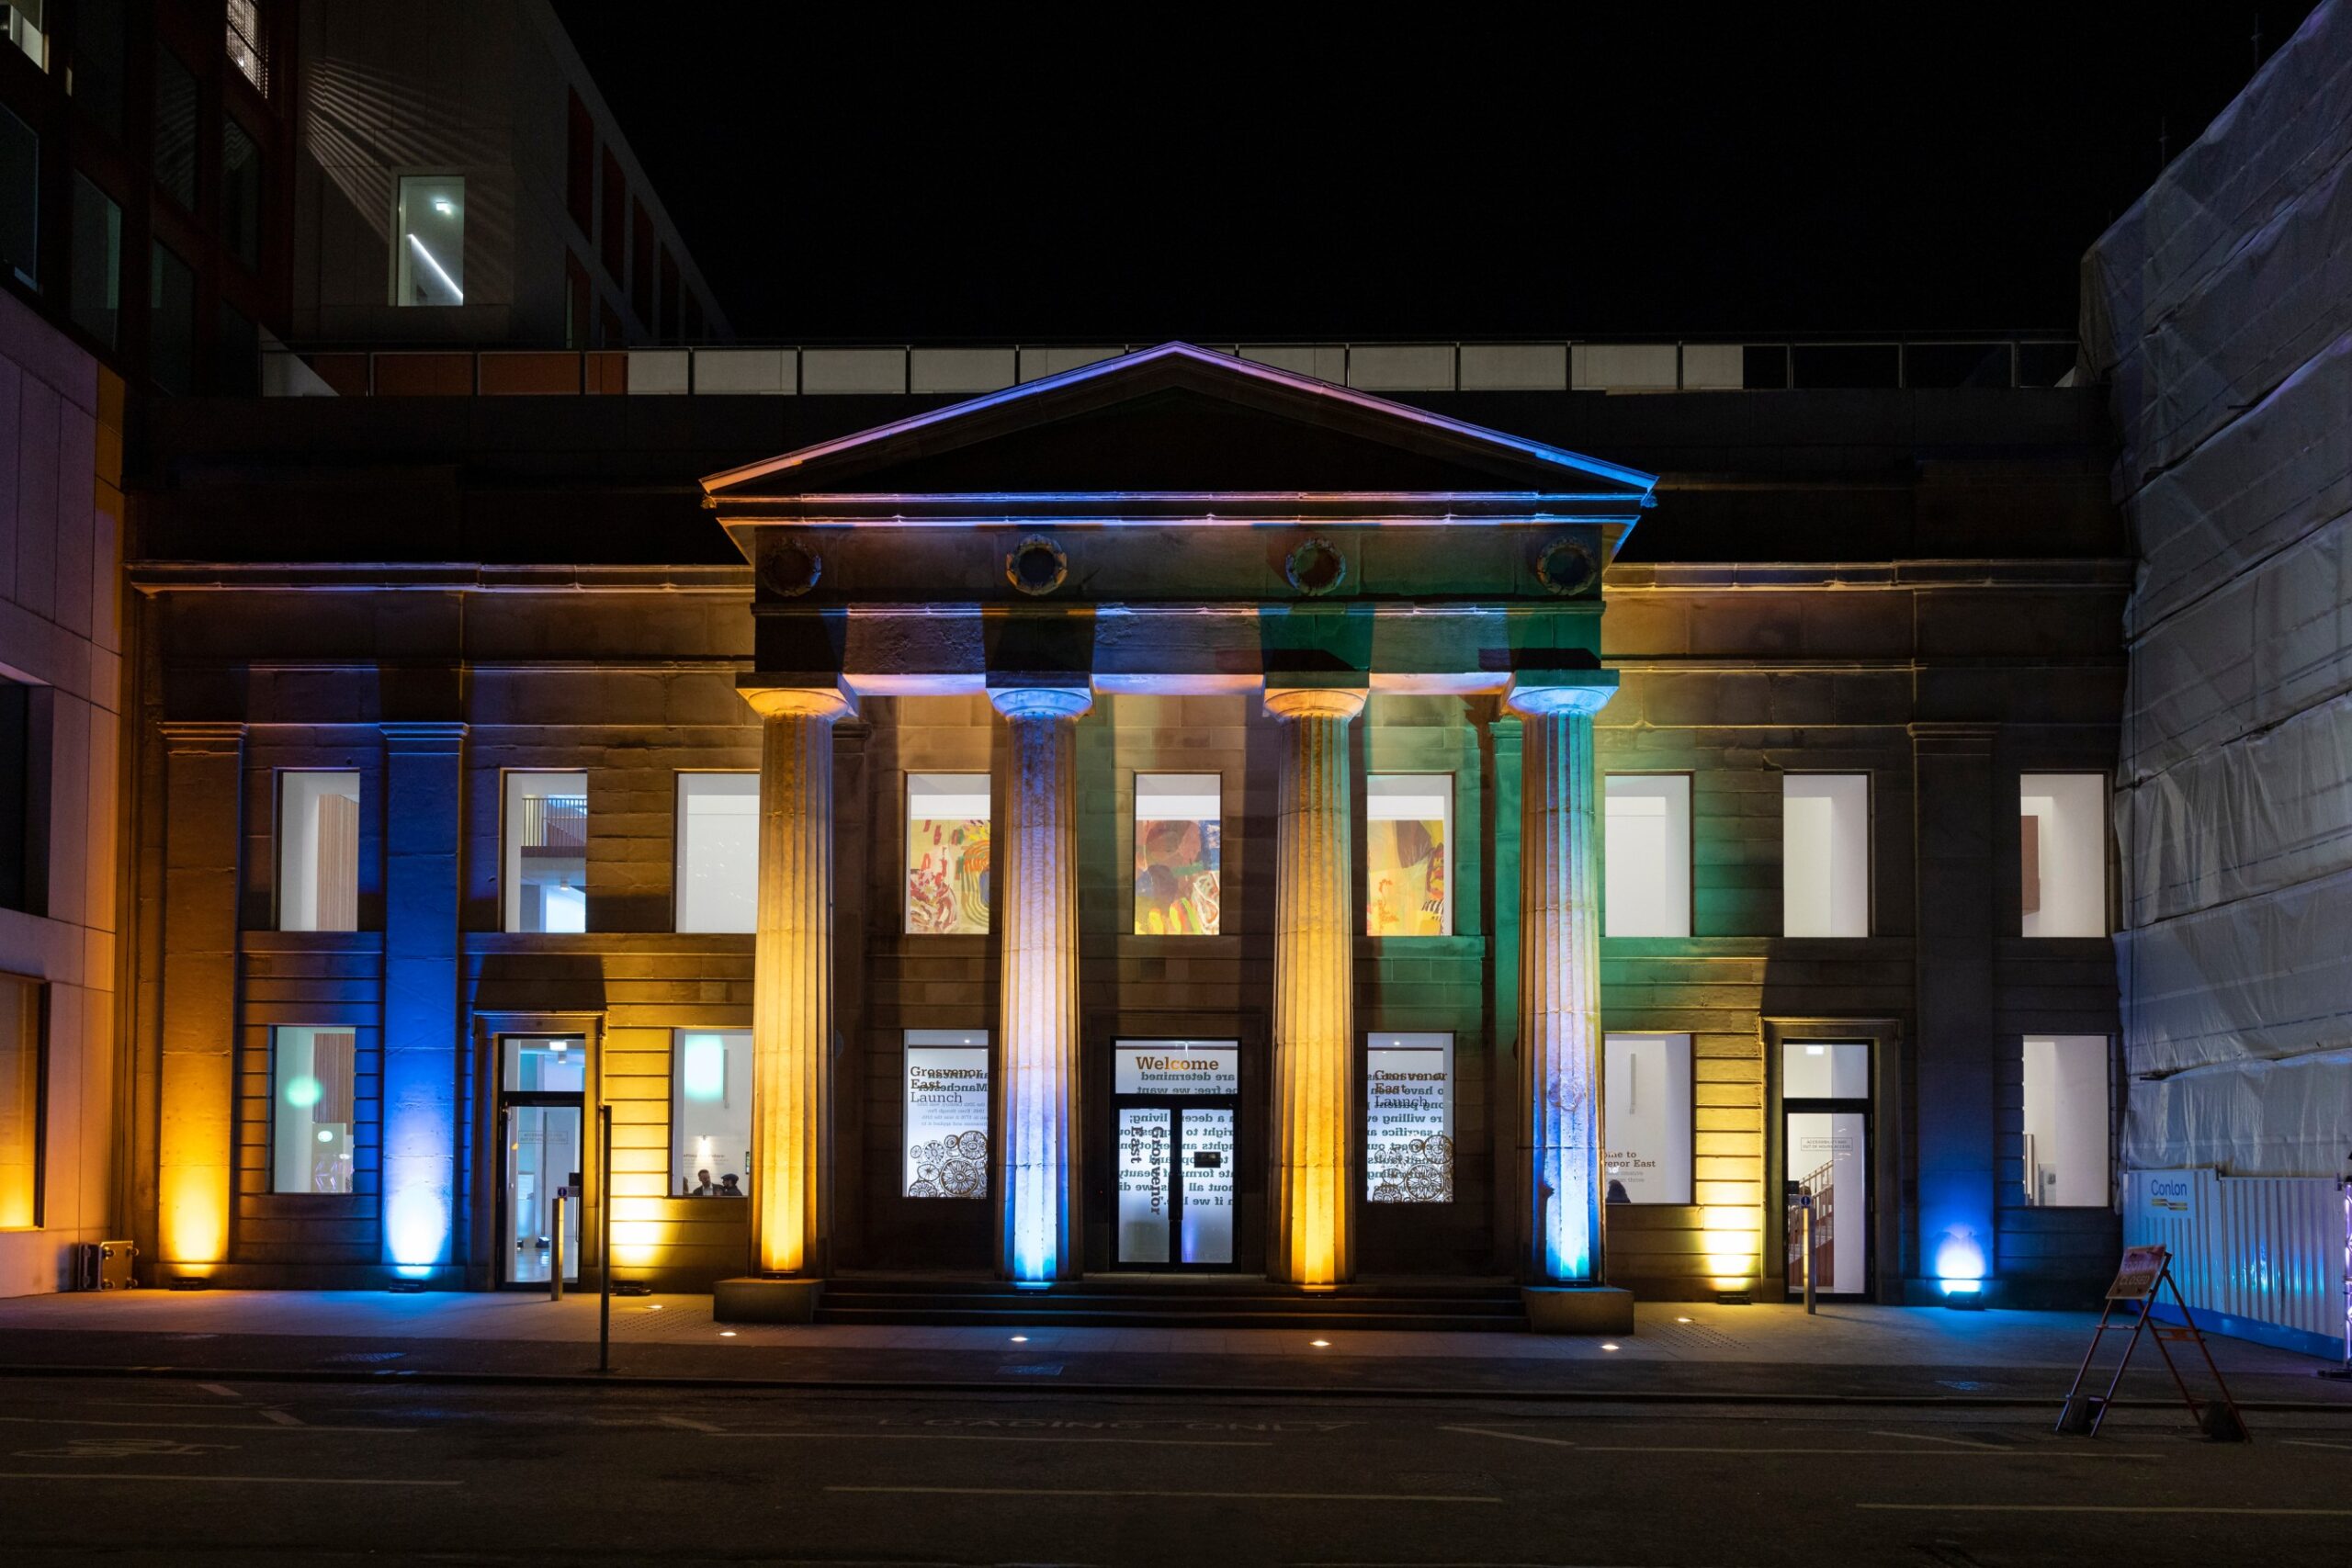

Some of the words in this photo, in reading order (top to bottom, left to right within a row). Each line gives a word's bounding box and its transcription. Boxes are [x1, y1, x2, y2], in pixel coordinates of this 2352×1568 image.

[1136, 1056, 1219, 1070] Welcome
[910, 1066, 982, 1077] Grosvenor
[1374, 1070, 1448, 1081] Grosvenor
[910, 1078, 942, 1089] East
[1374, 1083, 1406, 1093] East
[910, 1091, 963, 1103] Launch
[1374, 1096, 1427, 1108] Launch
[1130, 1126, 1144, 1164] East
[1634, 1159, 1657, 1168] East
[1151, 1126, 1164, 1214] Grosvenor
[2151, 1179, 2188, 1196] Conlon
[879, 1418, 1144, 1428] LOADING
